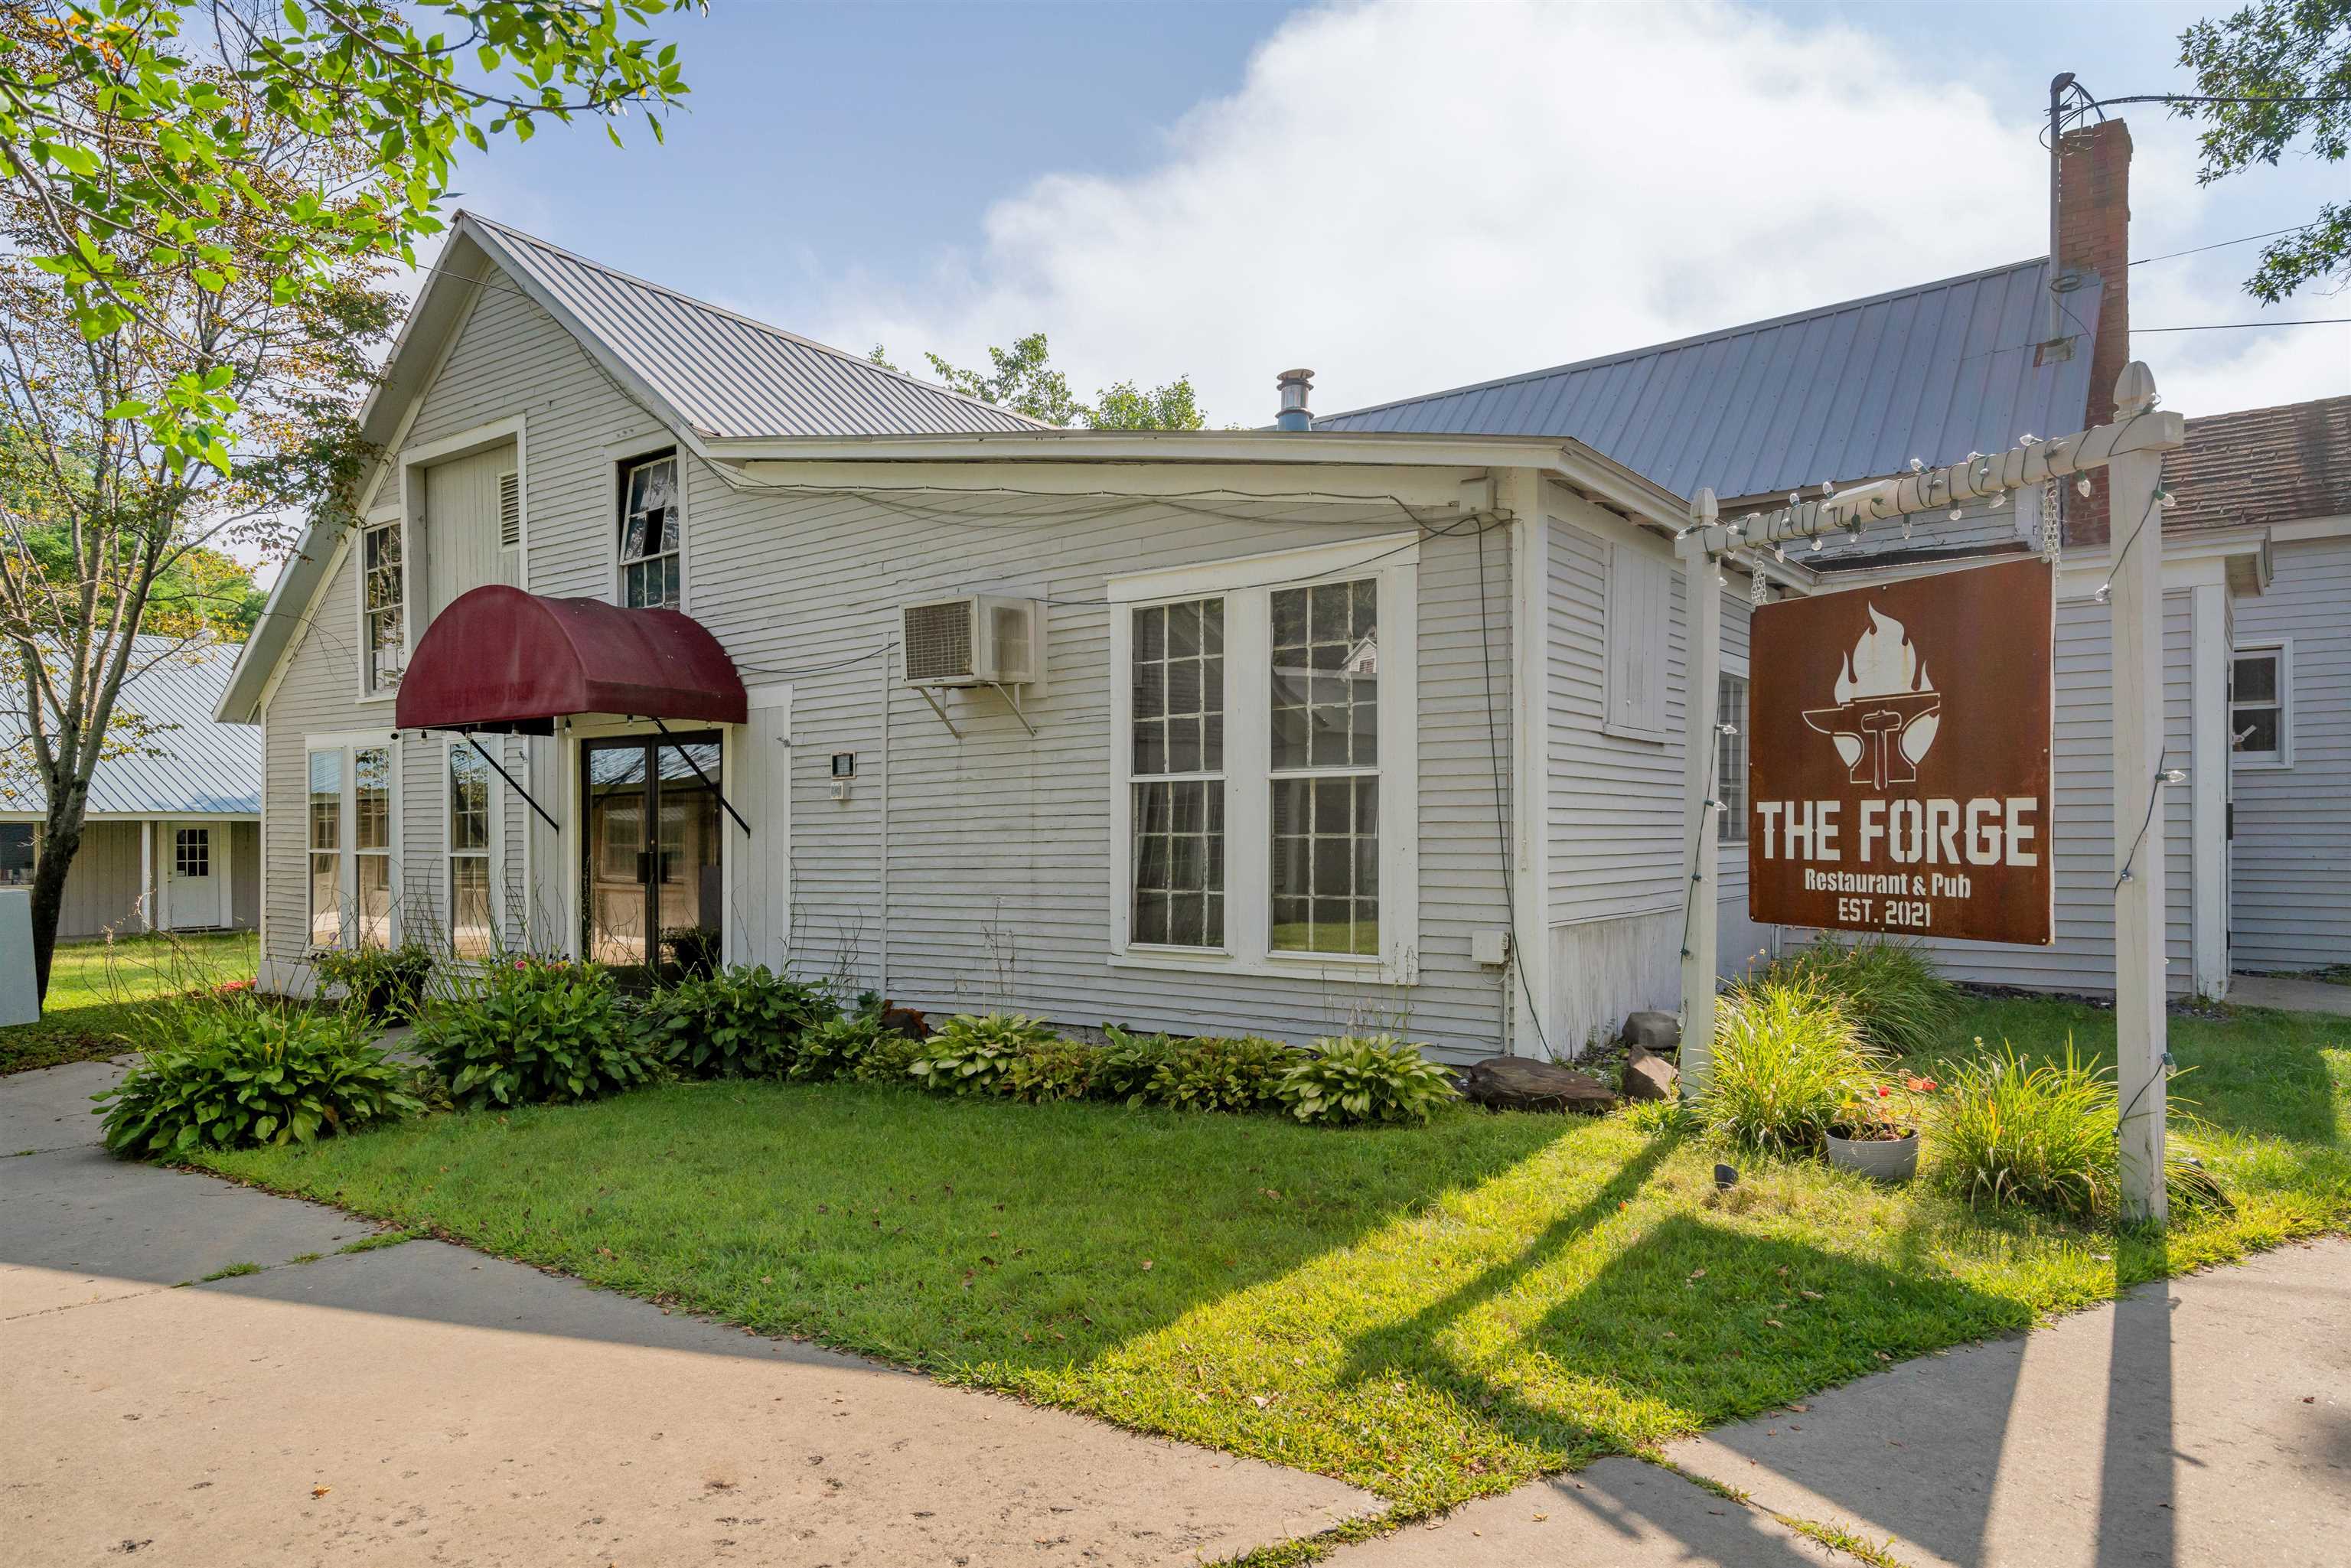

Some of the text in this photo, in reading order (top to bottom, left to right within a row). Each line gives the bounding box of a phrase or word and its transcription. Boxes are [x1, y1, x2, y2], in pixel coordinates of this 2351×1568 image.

[1756, 797, 2037, 866] THE FORGE
[1805, 869, 1971, 898] Restaurant & Pub
[1838, 898, 1931, 927] EST. 2021
